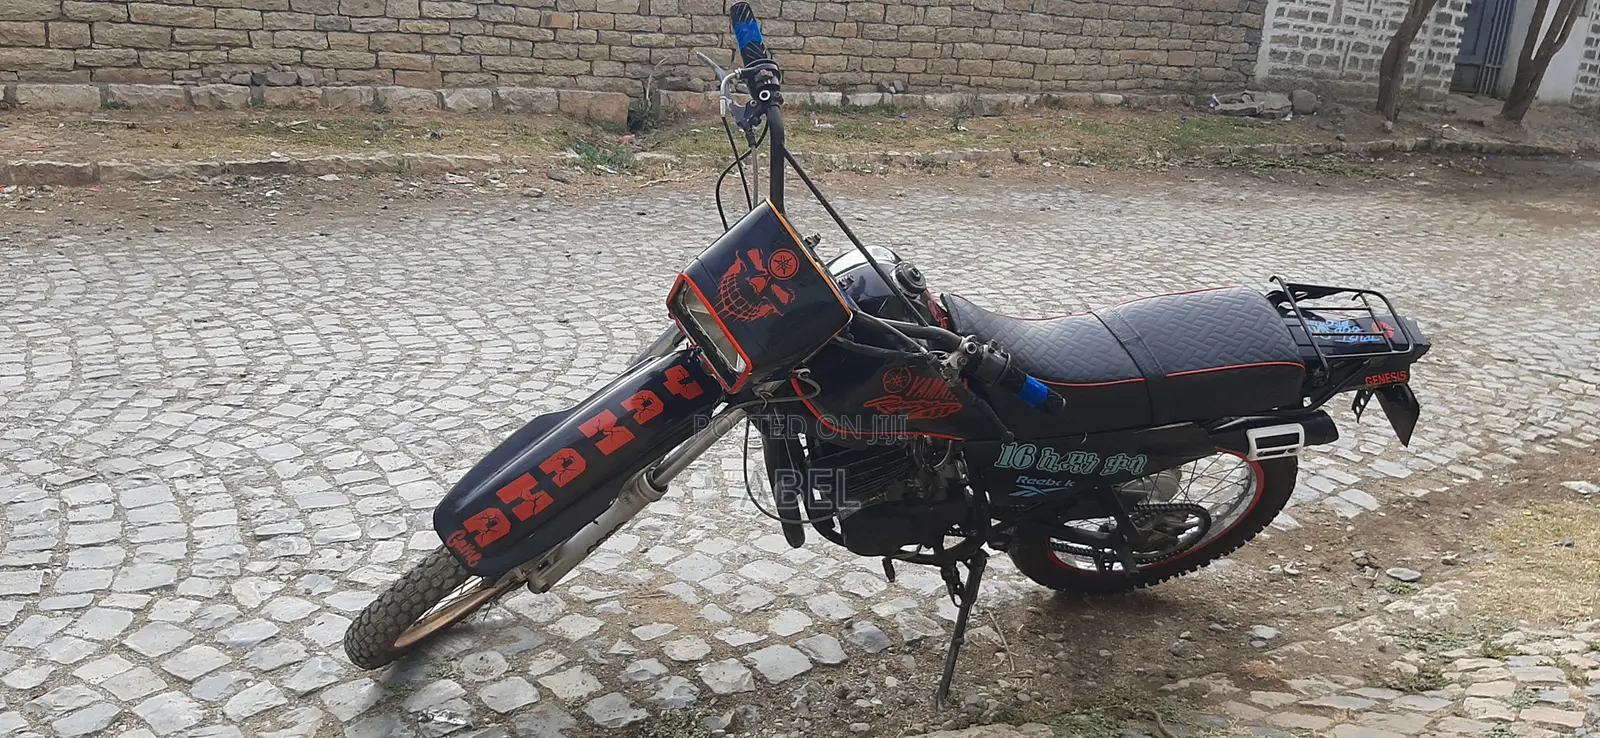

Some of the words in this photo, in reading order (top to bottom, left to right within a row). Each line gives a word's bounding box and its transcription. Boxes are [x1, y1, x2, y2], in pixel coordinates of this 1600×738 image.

[906, 376, 969, 400] YAMA
[1365, 370, 1408, 386] GENESIS
[462, 364, 704, 548] YAMAHA
[994, 441, 1037, 470] 16
[446, 529, 482, 567] Game
